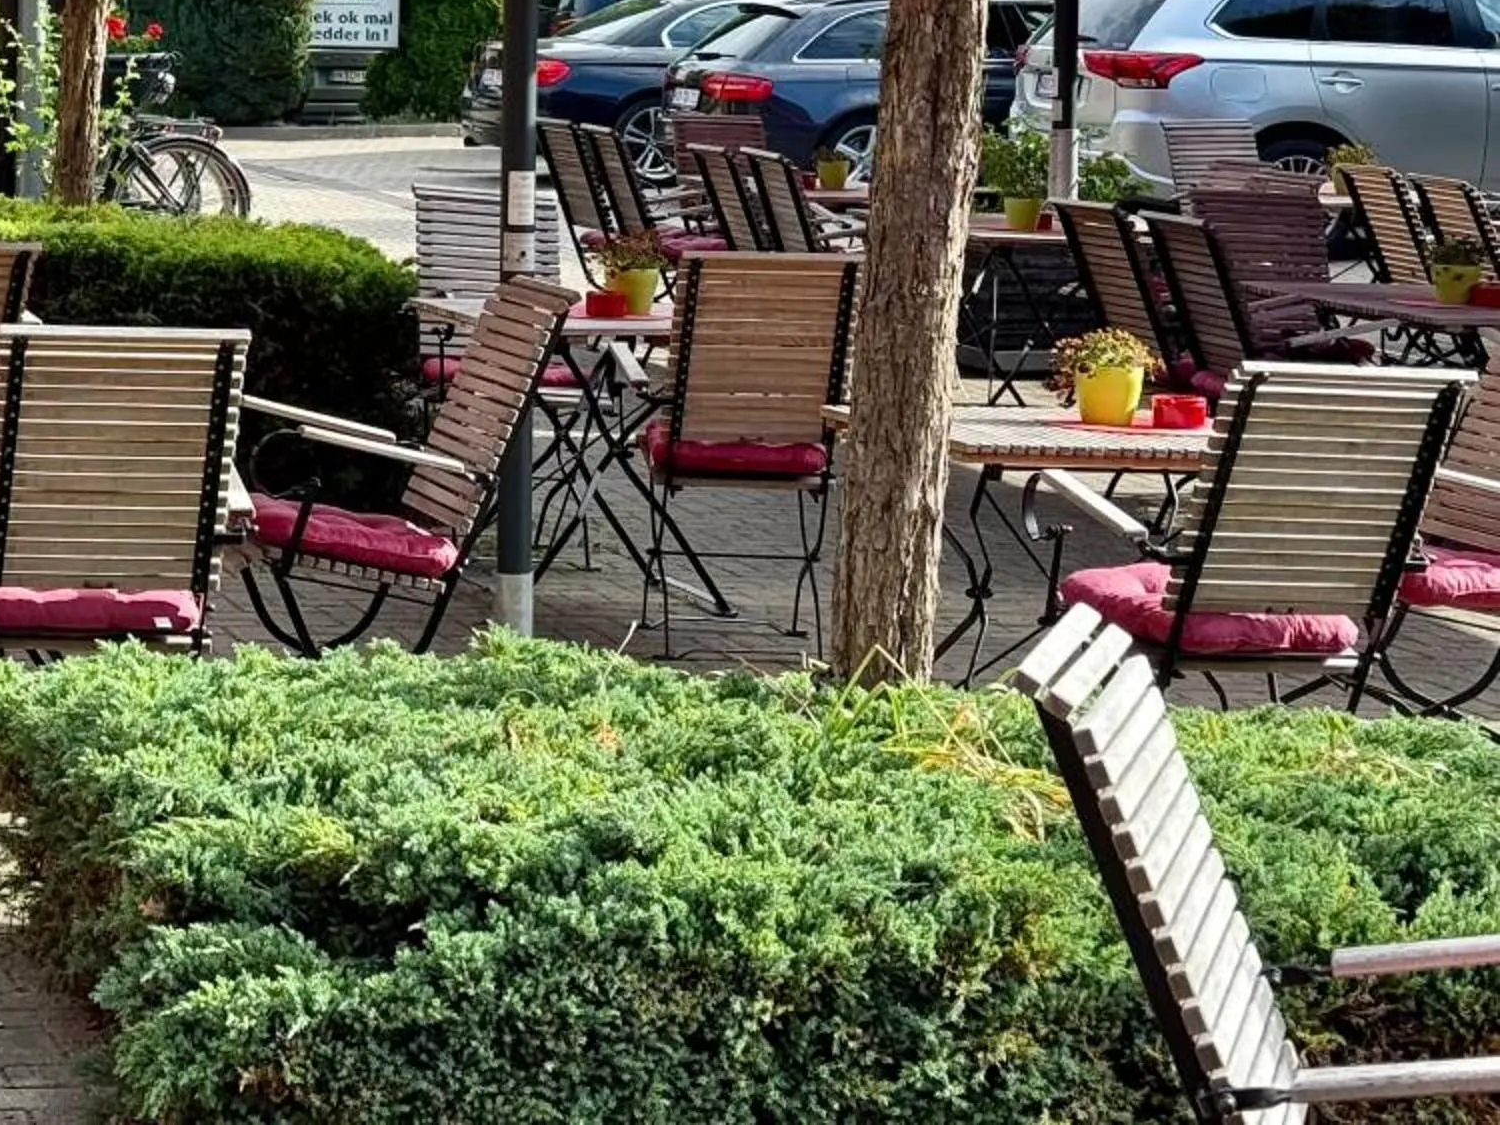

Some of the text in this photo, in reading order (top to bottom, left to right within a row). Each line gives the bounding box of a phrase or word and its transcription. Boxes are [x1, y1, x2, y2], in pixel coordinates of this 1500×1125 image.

[338, 10, 360, 24] ok
[363, 10, 393, 25] mal
[310, 26, 360, 41] edder
